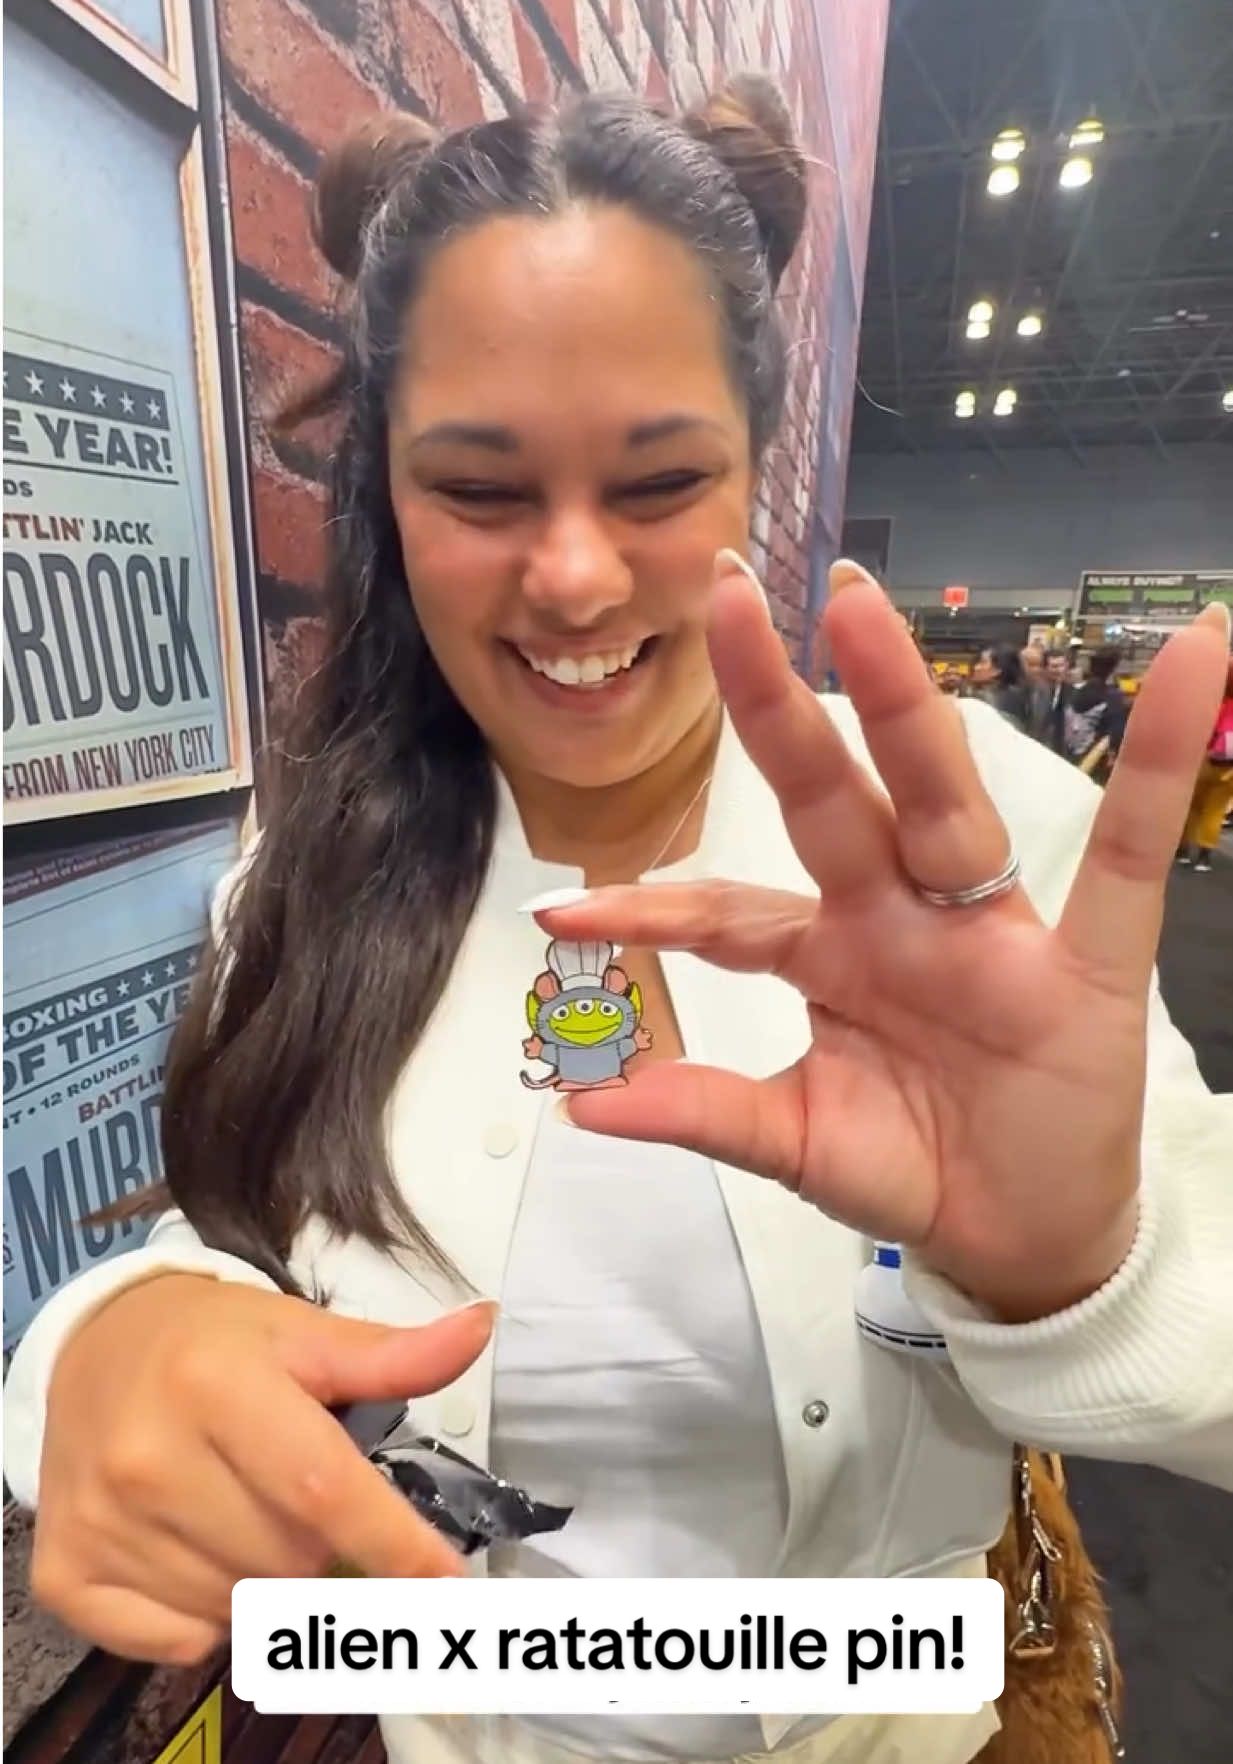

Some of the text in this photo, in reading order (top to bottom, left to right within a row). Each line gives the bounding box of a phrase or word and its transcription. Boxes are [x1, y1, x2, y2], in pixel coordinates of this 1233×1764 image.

[35, 412, 173, 475] YEAR!
[93, 518, 154, 545] JACK
[73, 742, 122, 791] NEW
[124, 731, 179, 782] YORK
[179, 723, 215, 769] CITY
[57, 1005, 140, 1064] THE
[40, 1092, 62, 1109] 12
[67, 1053, 141, 1097] ROUNDS
